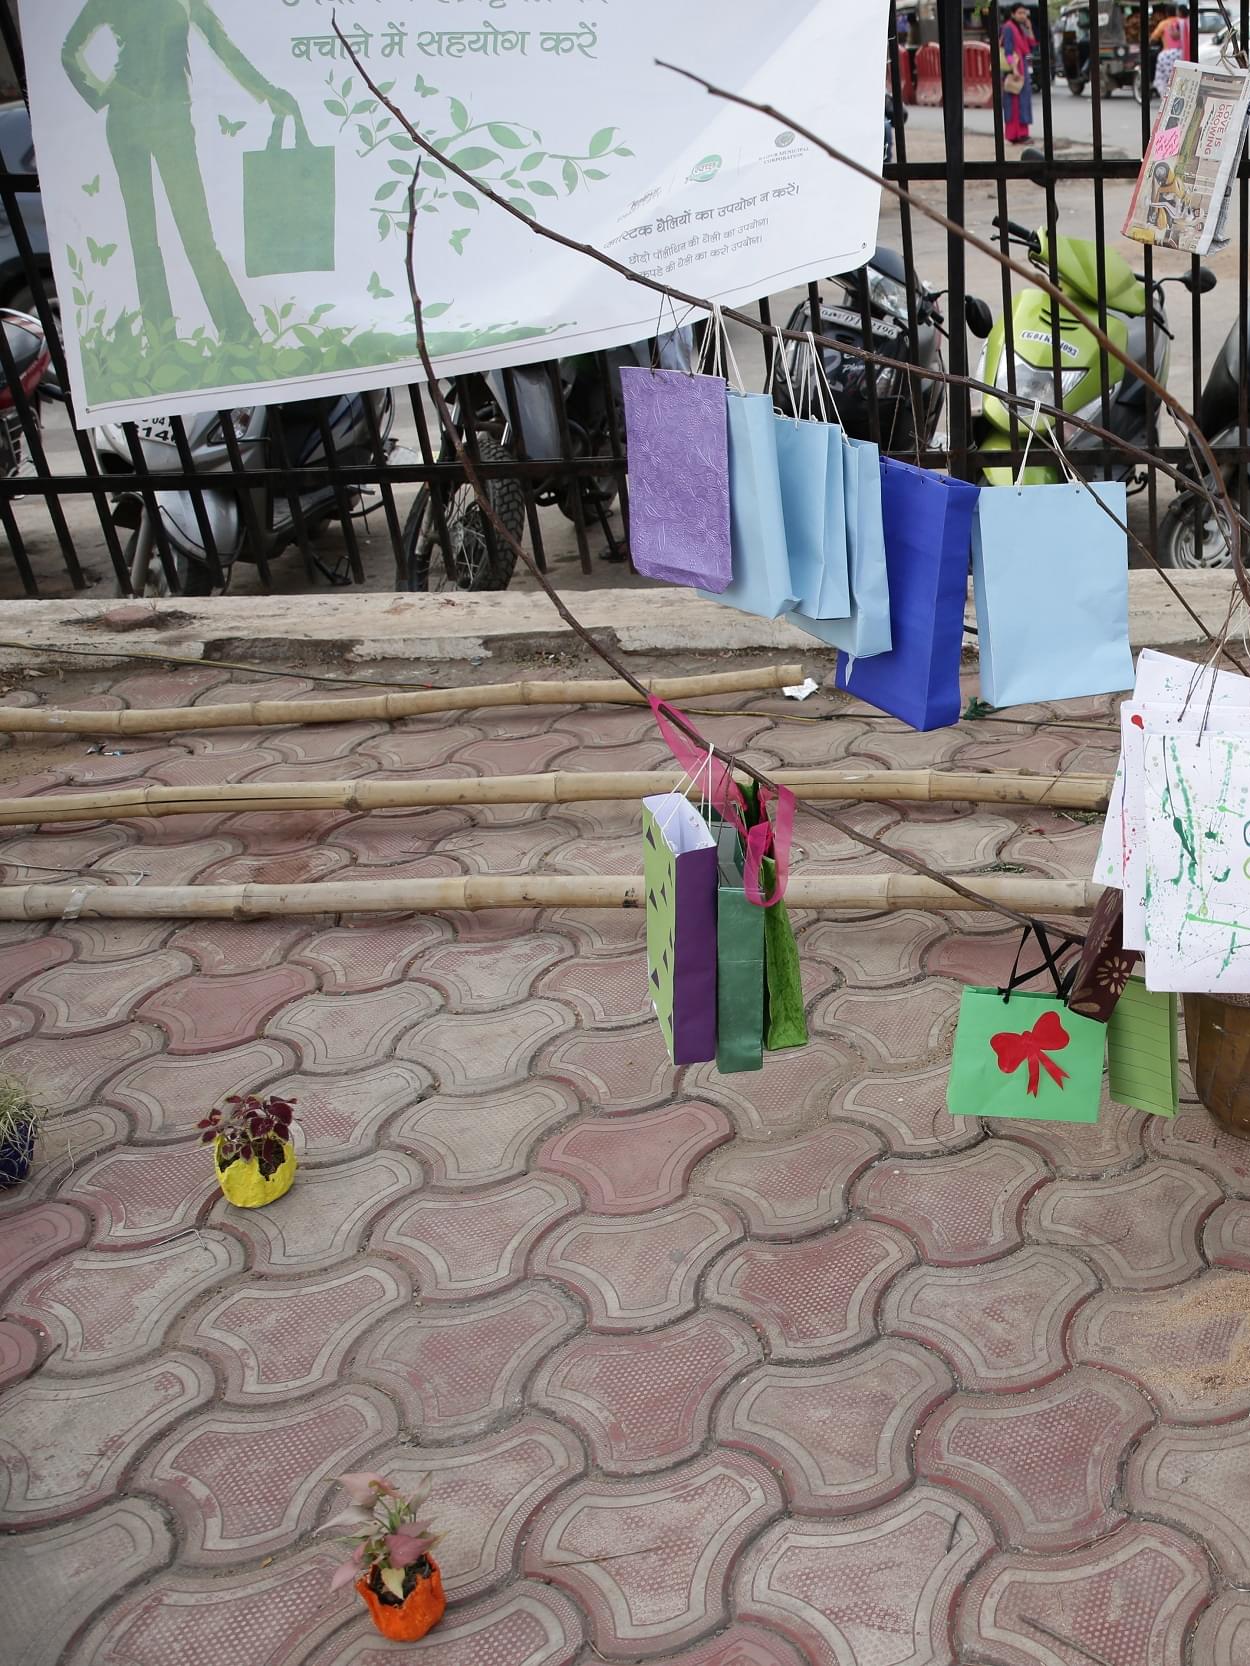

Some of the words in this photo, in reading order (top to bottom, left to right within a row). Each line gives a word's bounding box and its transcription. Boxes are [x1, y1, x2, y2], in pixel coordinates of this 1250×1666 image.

[291, 23, 374, 62] बचाने
[381, 21, 408, 59] में
[416, 20, 531, 57] सहयोग
[540, 21, 598, 59] करें
[1204, 103, 1226, 155] GROWING
[1218, 104, 1232, 134] LOVE
[1214, 137, 1223, 147] IS
[695, 208, 713, 222] का
[759, 191, 770, 202] न
